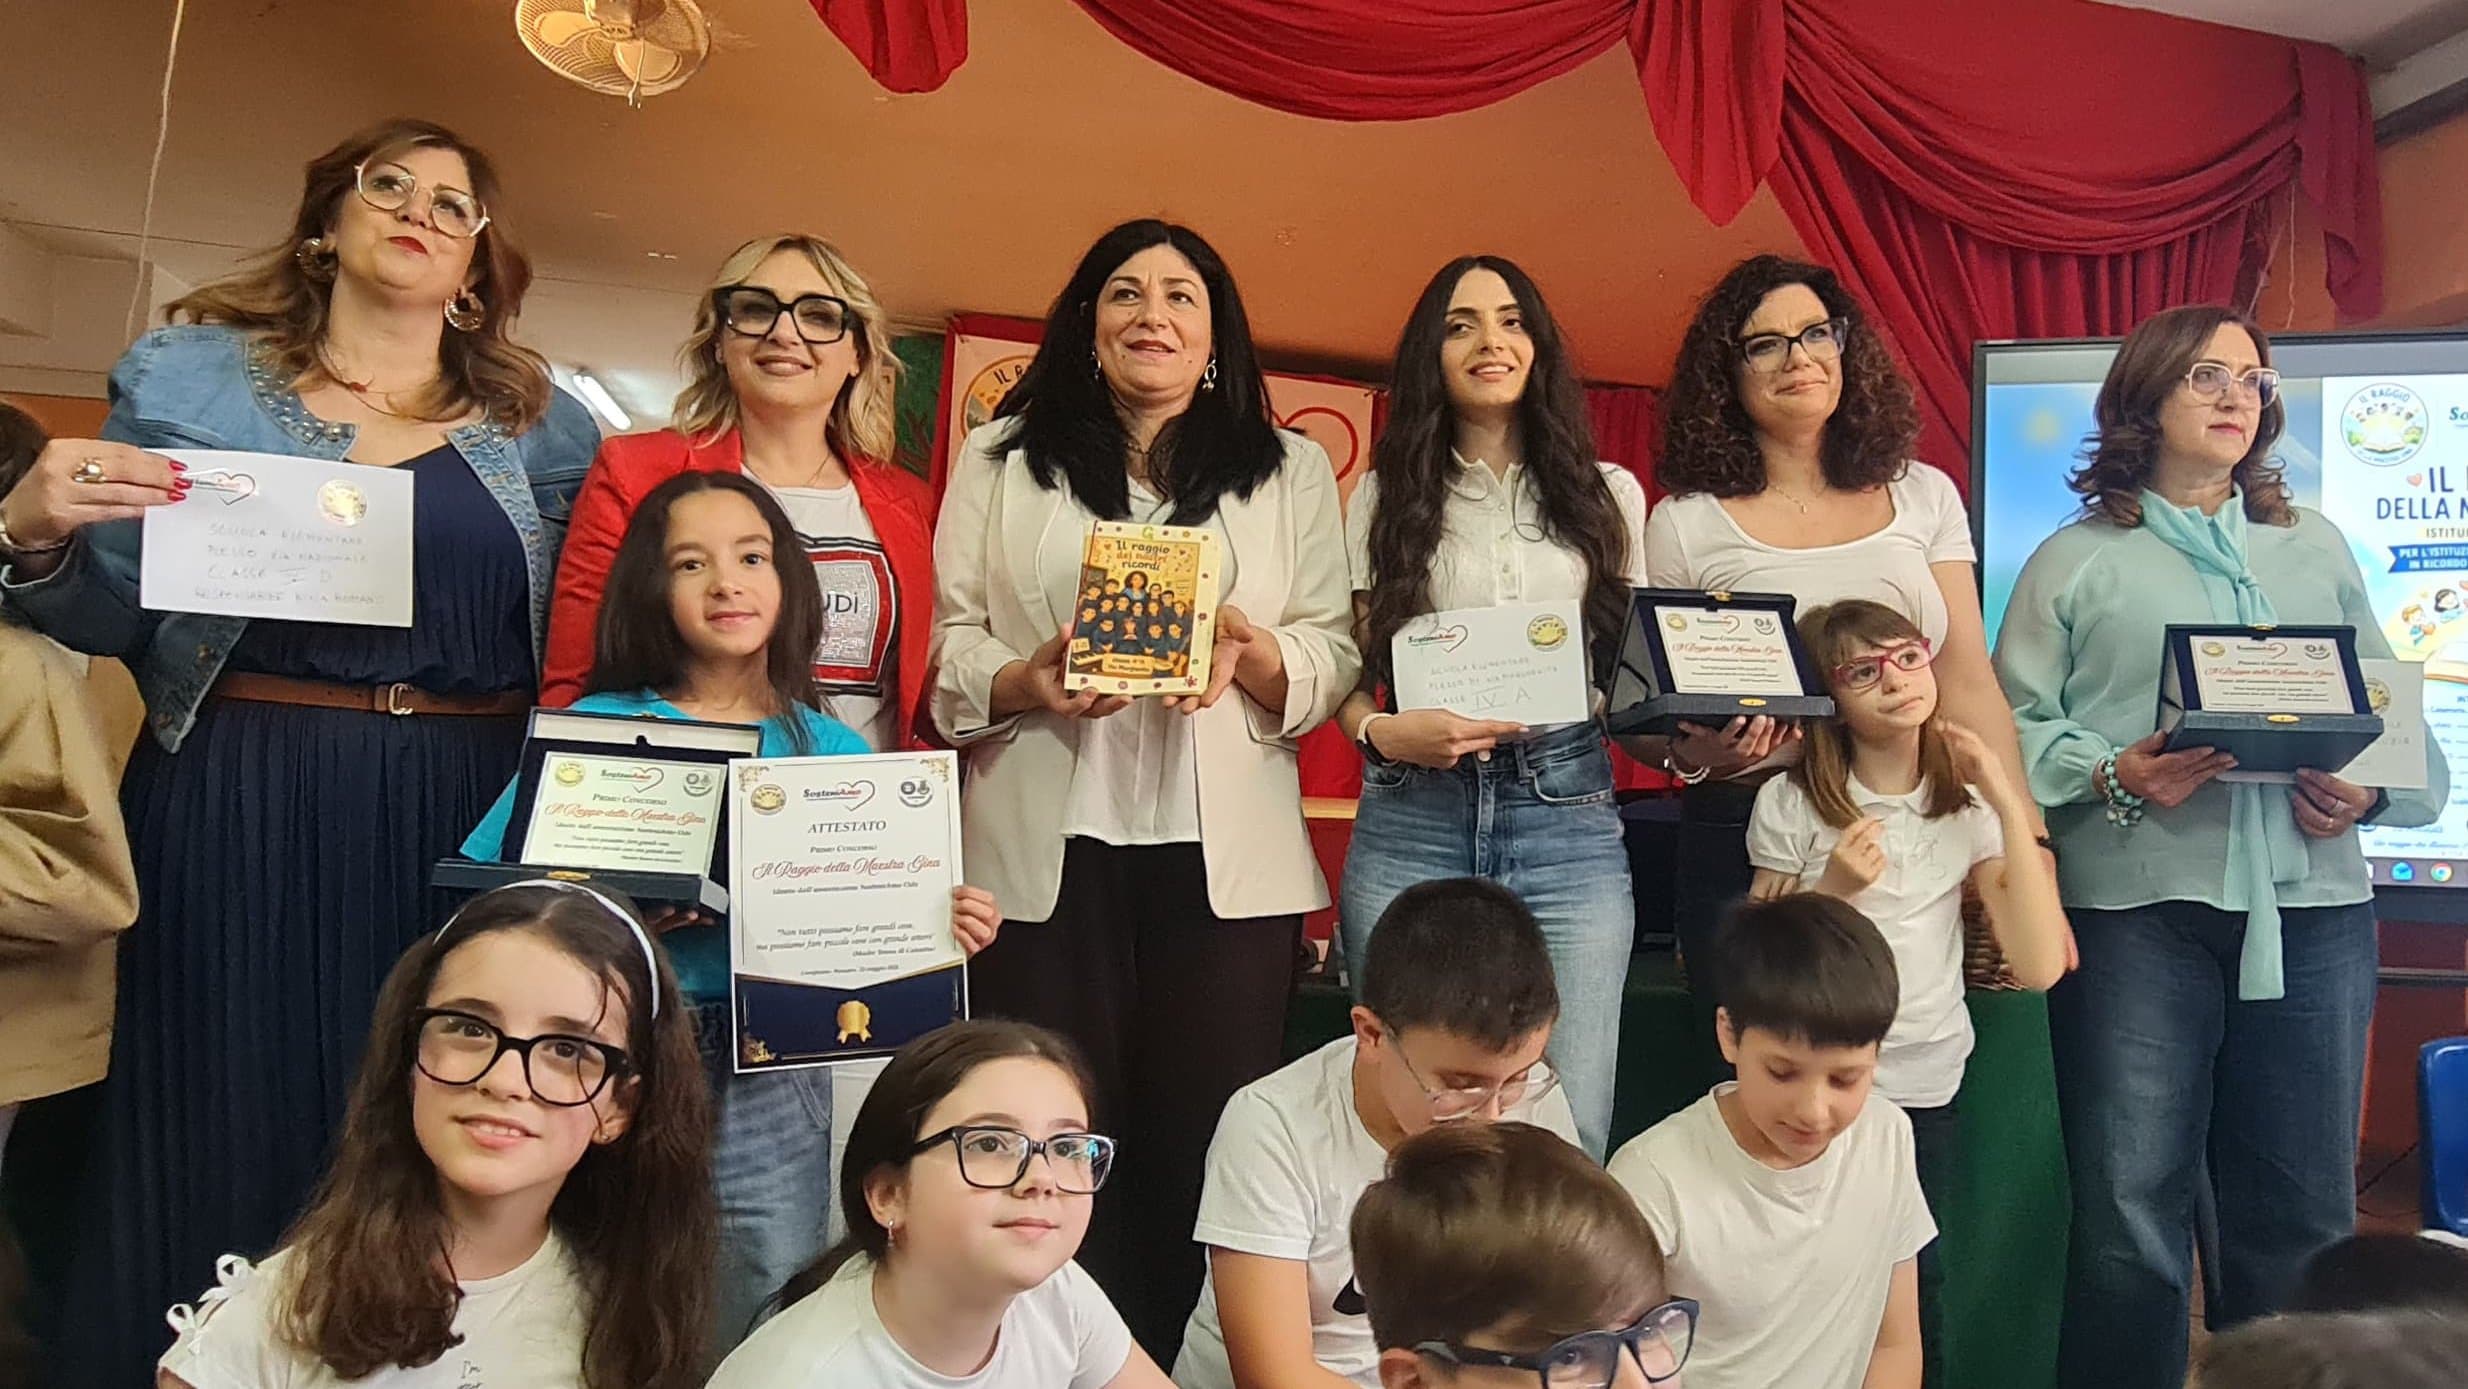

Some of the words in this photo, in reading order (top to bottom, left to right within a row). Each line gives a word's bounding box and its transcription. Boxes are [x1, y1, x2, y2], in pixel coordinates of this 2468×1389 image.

[993, 367, 1011, 385] IL
[2370, 387, 2411, 403] RAGGIO
[2429, 466, 2454, 493] IL
[2376, 497, 2450, 520] DELLA
[2426, 528, 2468, 538] ISTITU
[1115, 540, 1127, 550] Il
[1131, 543, 1170, 554] raggio
[2399, 547, 2418, 558] PER
[2421, 546, 2468, 558] L'ISTITUZ
[1121, 561, 1161, 571] ricordi
[564, 803, 603, 818] Raggio
[603, 808, 629, 818] della
[631, 808, 676, 824] Maestra
[677, 811, 706, 826] Gina
[808, 820, 887, 834] ATTESTATO
[752, 862, 774, 880] Il
[774, 861, 823, 879] Raggio
[823, 860, 850, 873] della
[853, 856, 905, 876] Maestra
[907, 854, 941, 873] Gina
